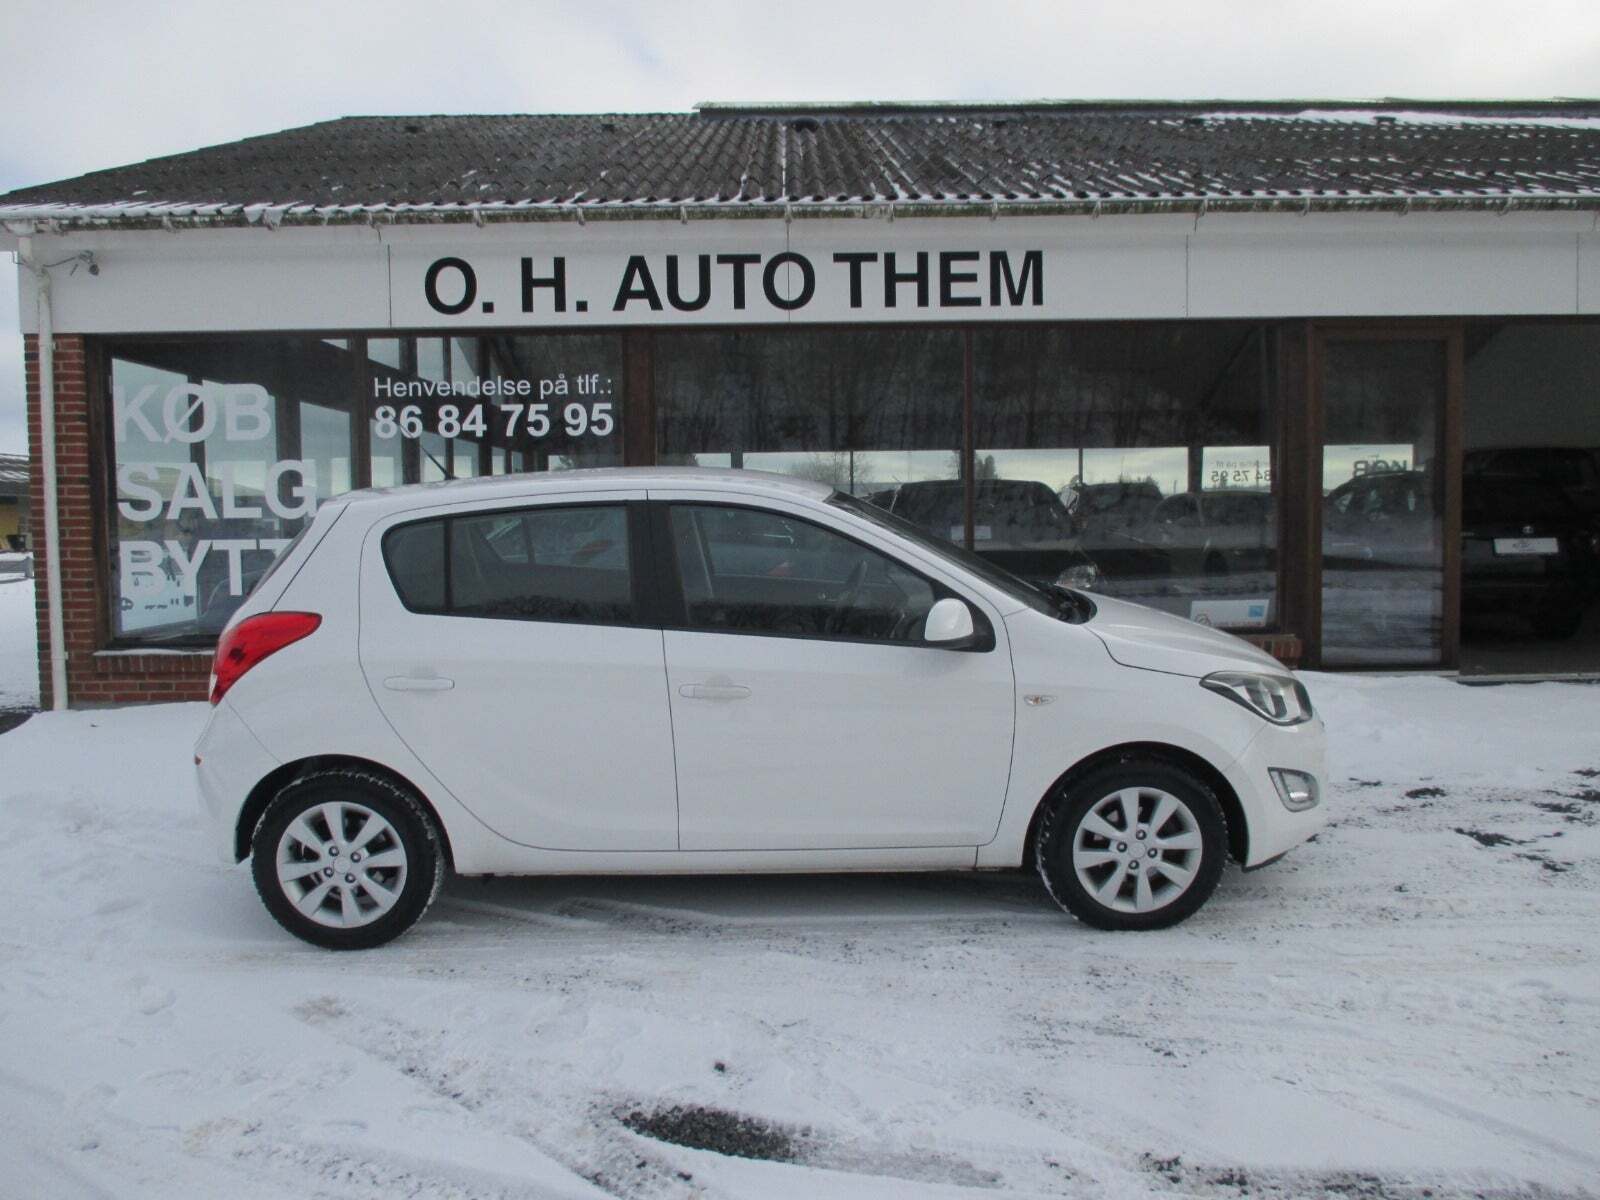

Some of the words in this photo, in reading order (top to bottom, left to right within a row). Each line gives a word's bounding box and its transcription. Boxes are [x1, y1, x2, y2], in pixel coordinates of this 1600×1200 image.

[424, 256, 494, 315] O.
[521, 256, 588, 313] H.
[612, 252, 816, 312] AUTO
[833, 250, 1043, 308] THEM
[114, 383, 272, 444] KØB
[373, 376, 531, 398] Henvendelse
[539, 373, 569, 400] på
[577, 374, 612, 395] tlf.:
[375, 405, 424, 439] 86
[438, 404, 488, 438] 84
[500, 403, 551, 437] 75
[564, 403, 614, 437] 95
[118, 459, 318, 522] SALG
